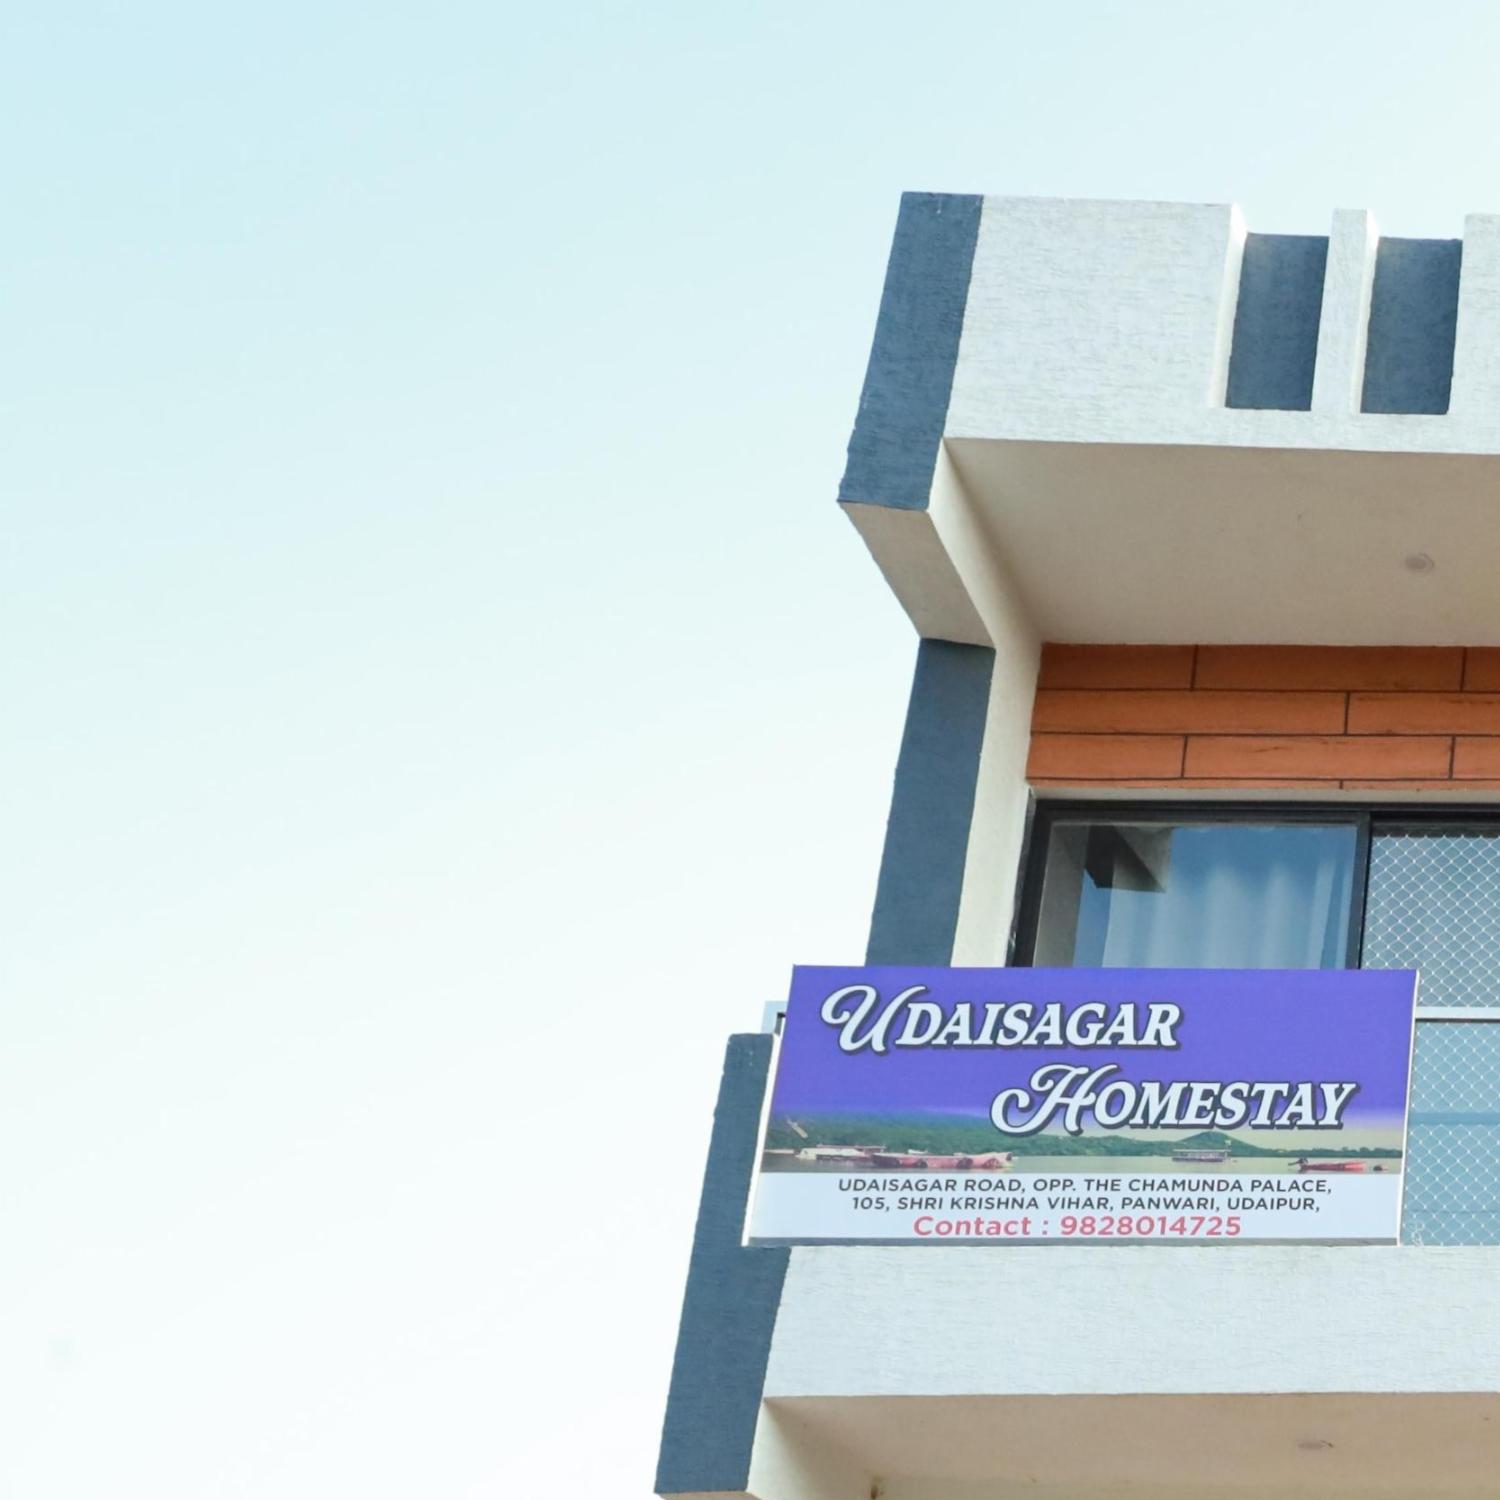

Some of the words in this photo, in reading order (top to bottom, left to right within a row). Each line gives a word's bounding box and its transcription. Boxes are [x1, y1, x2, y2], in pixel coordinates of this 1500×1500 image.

[821, 984, 1181, 1054] UDAISAGAR
[990, 1062, 1357, 1135] HOMESTAY
[838, 1178, 957, 1192] UDAISAGAR
[964, 1178, 1026, 1194] ROAD,
[1032, 1178, 1076, 1192] OPP.
[1084, 1178, 1121, 1192] THE
[1128, 1178, 1243, 1193] CHAMUNDA
[1250, 1179, 1332, 1195] PALACE,
[852, 1196, 890, 1212] 105,
[897, 1196, 943, 1210] SHRI
[950, 1196, 1039, 1210] KRISHNA
[1047, 1196, 1114, 1212] VIHAR,
[1121, 1197, 1220, 1212] PANWARI,
[1227, 1197, 1320, 1213] UDAIPUR,
[913, 1215, 1031, 1236] Contact
[1060, 1215, 1242, 1237] 9828014725
